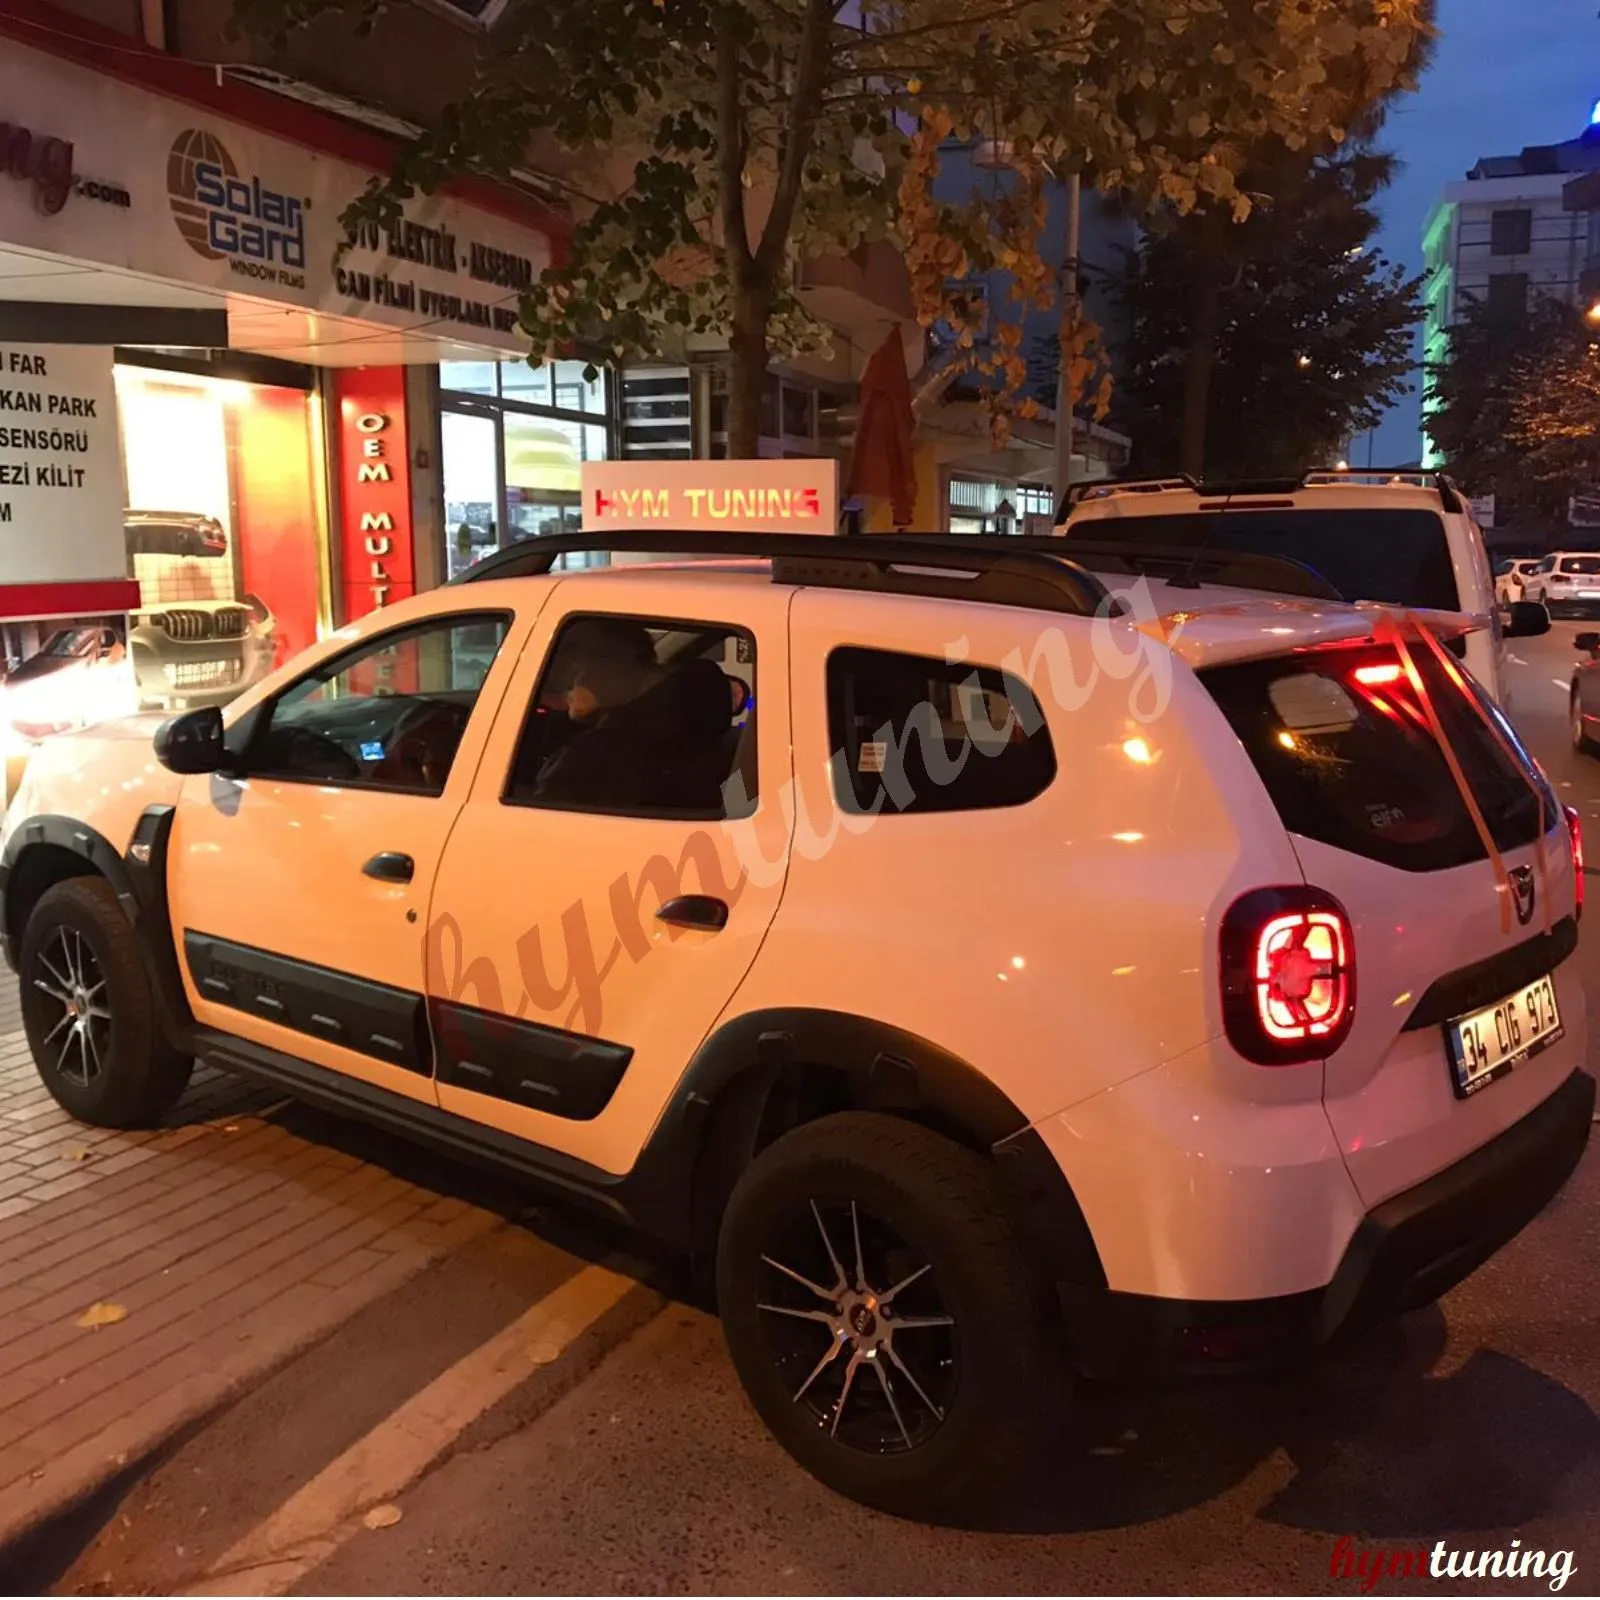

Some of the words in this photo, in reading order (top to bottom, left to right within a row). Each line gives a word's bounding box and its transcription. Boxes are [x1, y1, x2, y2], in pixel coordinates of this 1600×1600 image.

[195, 162, 301, 228] Solar
[209, 211, 305, 268] Gard
[229, 258, 277, 281] WINDOW
[278, 270, 305, 289] FILMS
[337, 267, 370, 301] CAM
[10, 353, 47, 376] FAR
[48, 395, 97, 418] PARK
[0, 427, 88, 452] SENSÖRÜ
[356, 413, 390, 482] OEM
[36, 464, 86, 488] KİLİT
[596, 489, 670, 518] HYM
[683, 489, 819, 518] TUNING
[1462, 1022, 1488, 1073] 34
[1494, 1001, 1521, 1055] CIG
[1526, 981, 1555, 1035] 973
